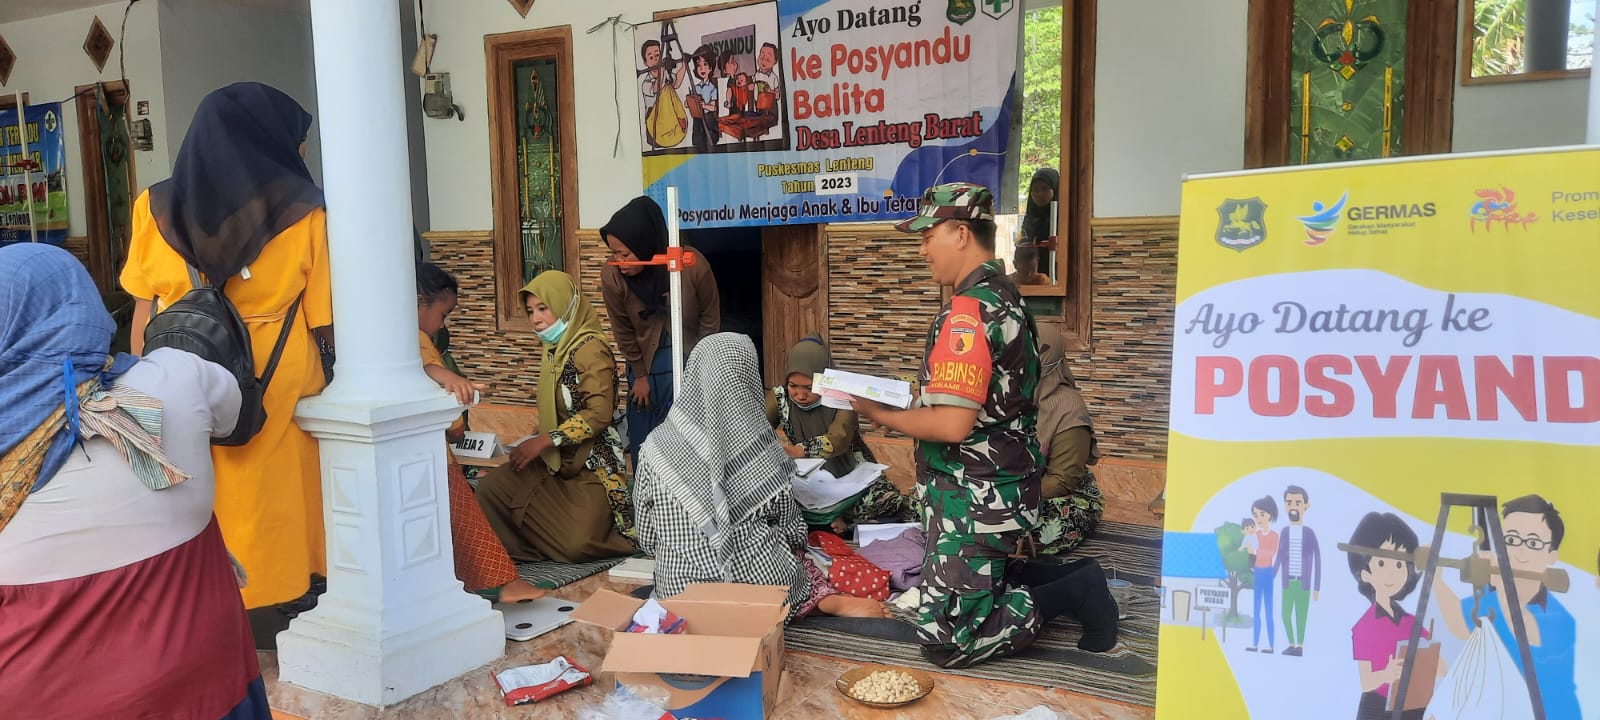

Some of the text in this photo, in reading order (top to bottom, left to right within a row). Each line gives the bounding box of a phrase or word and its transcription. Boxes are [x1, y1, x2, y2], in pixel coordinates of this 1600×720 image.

[792, 1, 921, 39] Ayo Datang
[707, 34, 754, 56] OSYANDU
[791, 26, 970, 81] ke Posyandu
[793, 82, 884, 120] Balita
[796, 111, 983, 151] Desa Lenteng Barat
[757, 156, 873, 177] Puskesmas Lenteng
[781, 177, 852, 194] Tahun 2023
[1552, 191, 1600, 204] Prom
[739, 203, 797, 223] Menjaga
[801, 200, 837, 217] Anak
[842, 200, 852, 214] &
[857, 197, 879, 214] Ibu
[1347, 202, 1437, 221] GERMAS
[1185, 293, 1493, 349] Ayo Datang ke
[932, 361, 983, 387] BABINSA
[1194, 354, 1600, 424] POSYAND
[478, 439, 485, 451] 2
